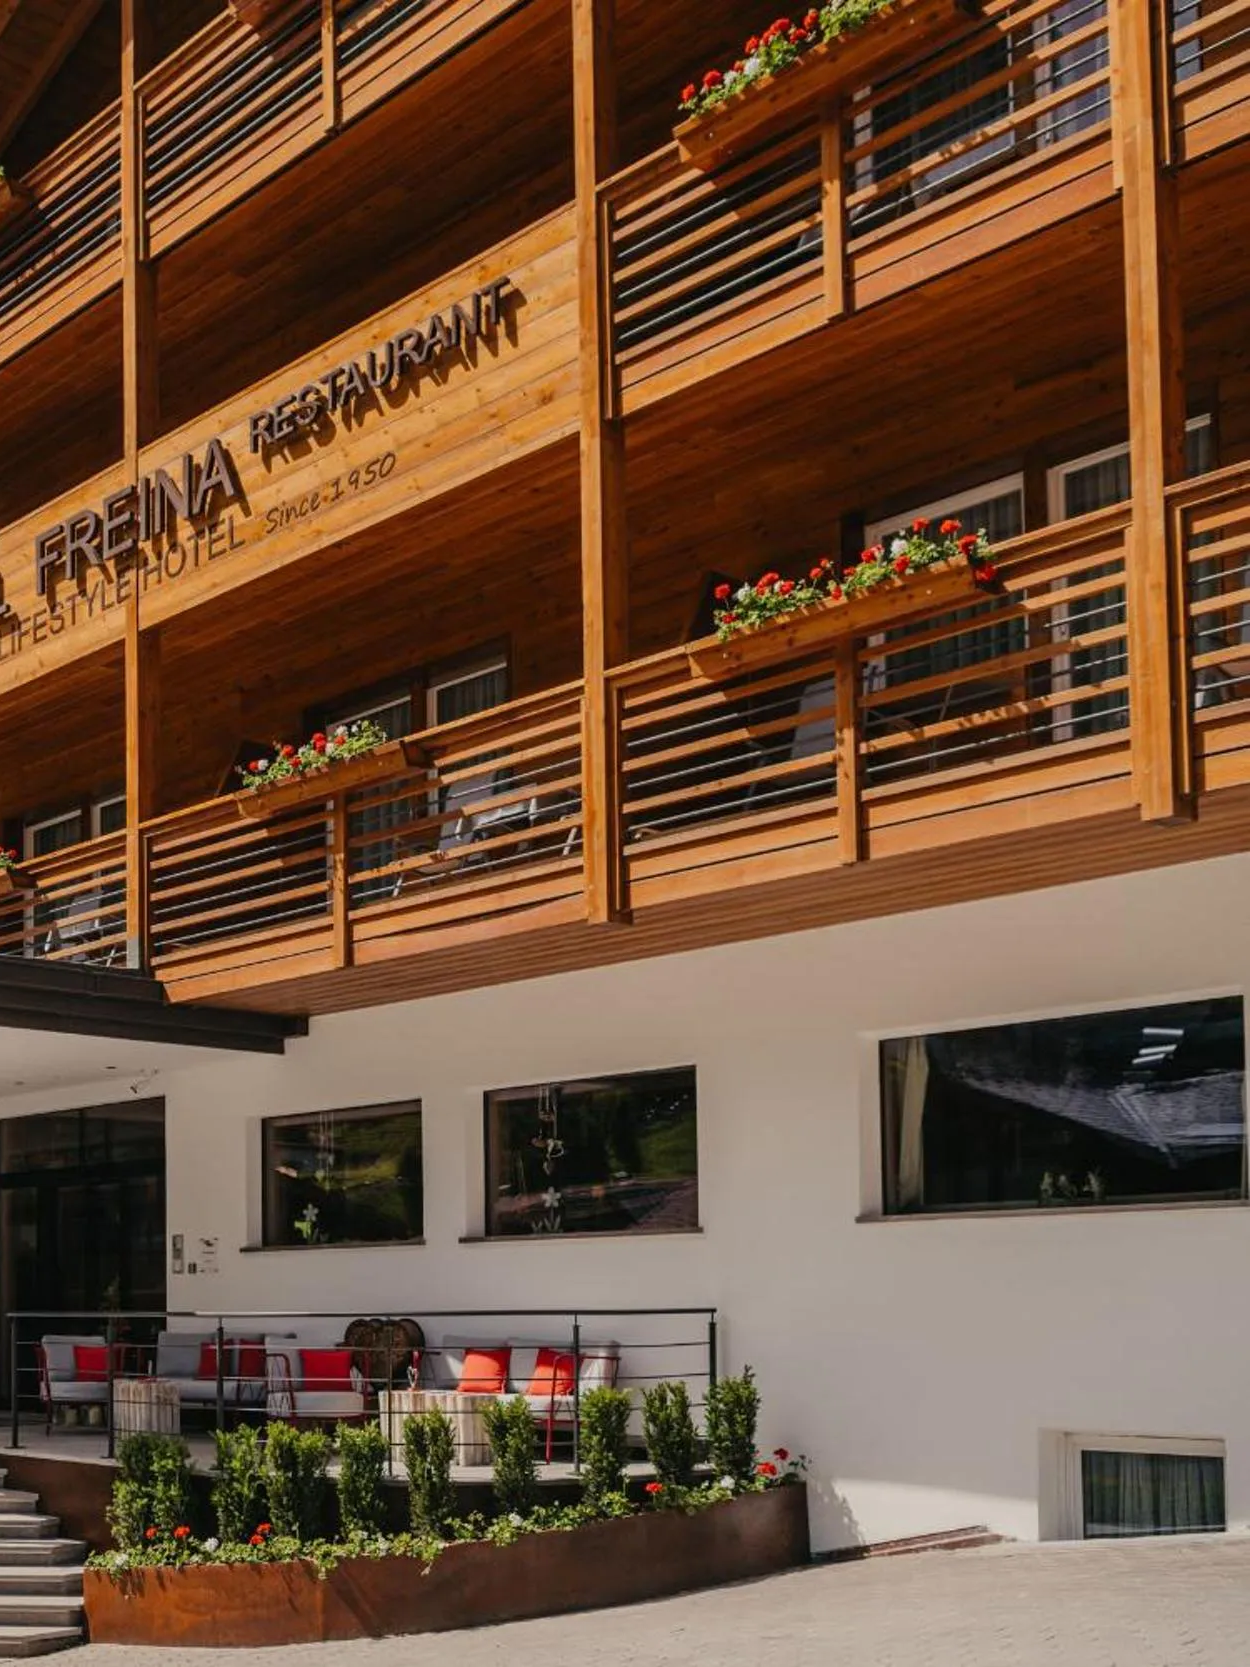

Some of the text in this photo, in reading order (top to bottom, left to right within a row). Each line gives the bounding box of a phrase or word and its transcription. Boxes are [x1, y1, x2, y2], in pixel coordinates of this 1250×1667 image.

[35, 438, 235, 595] FREINA
[250, 276, 511, 454] RESTAURANT
[143, 515, 247, 591] HOTEL
[265, 489, 322, 534] Since
[331, 452, 397, 502] 1950
